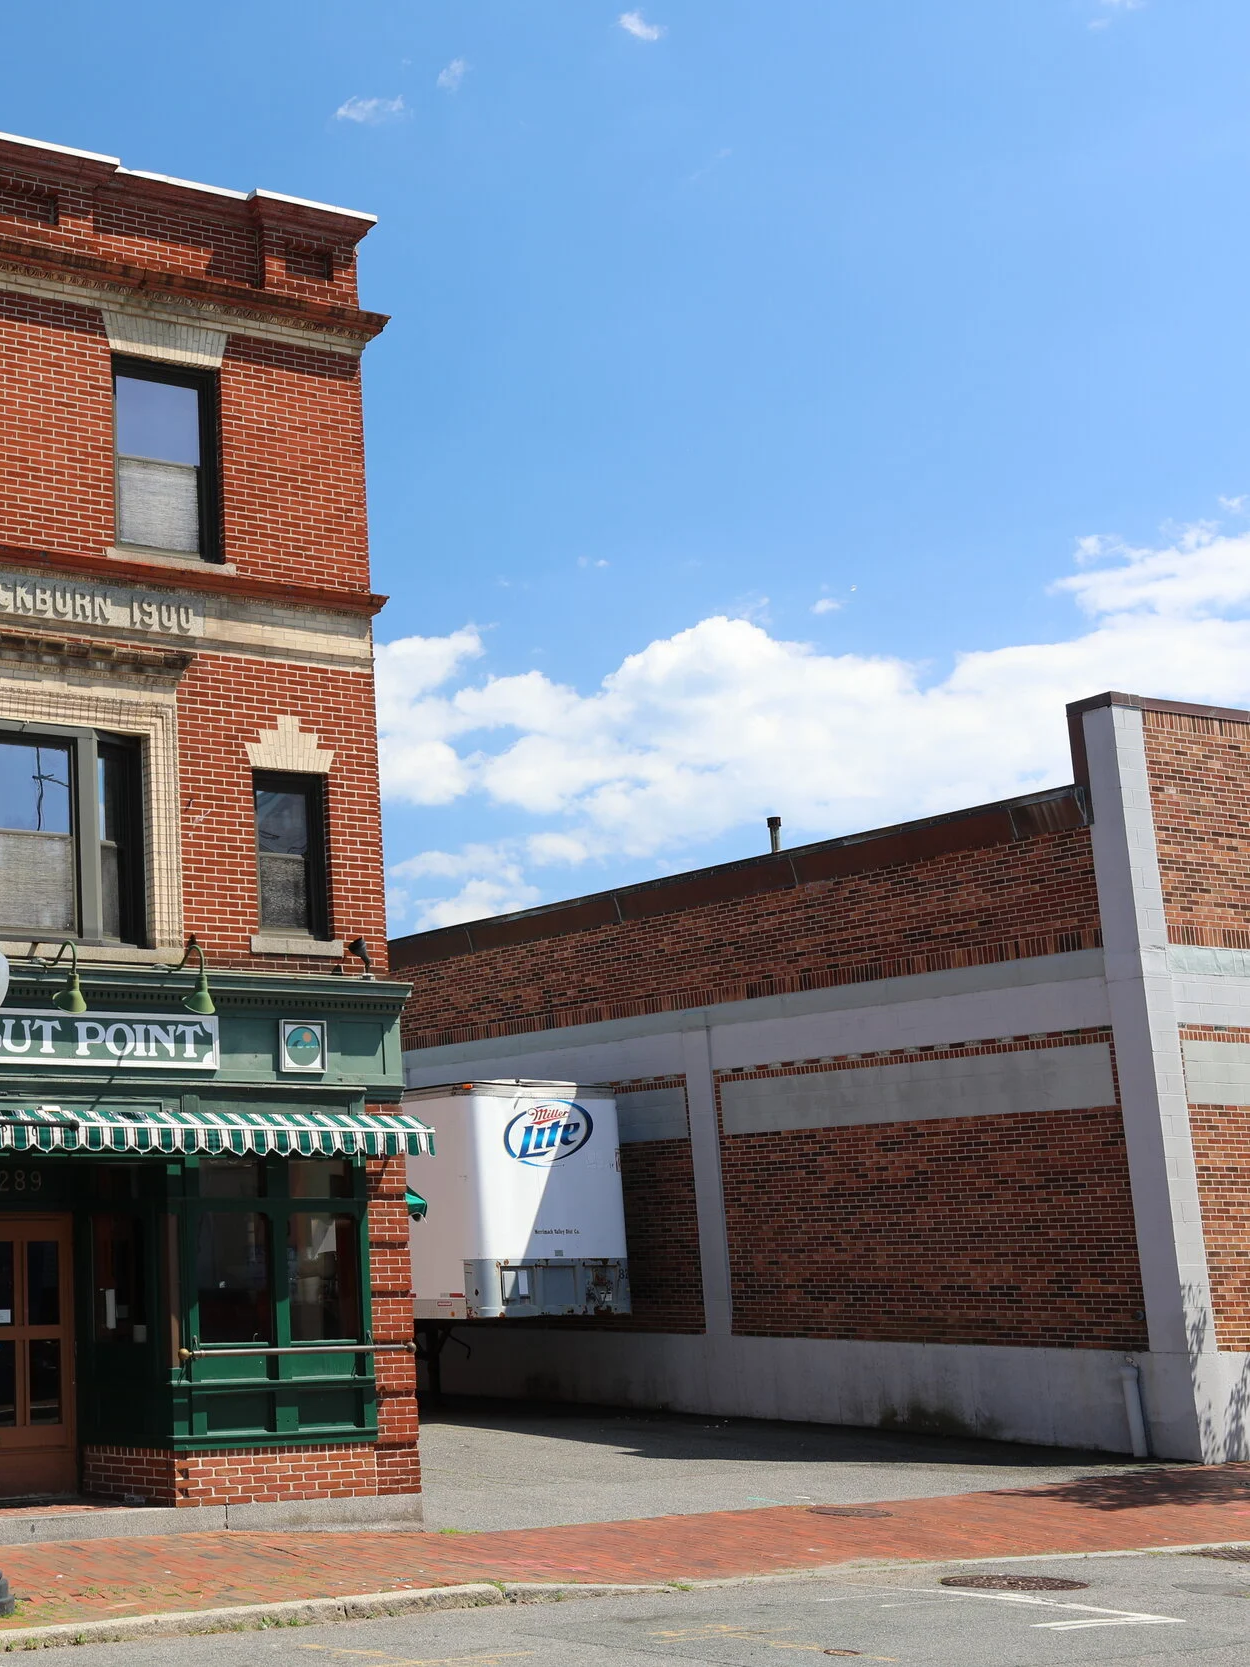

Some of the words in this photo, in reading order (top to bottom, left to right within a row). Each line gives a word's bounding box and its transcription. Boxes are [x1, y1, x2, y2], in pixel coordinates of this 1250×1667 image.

[130, 597, 194, 634] 1900
[74, 1022, 203, 1058] POINT
[528, 1107, 569, 1121] Miller
[517, 1120, 580, 1158] Lite
